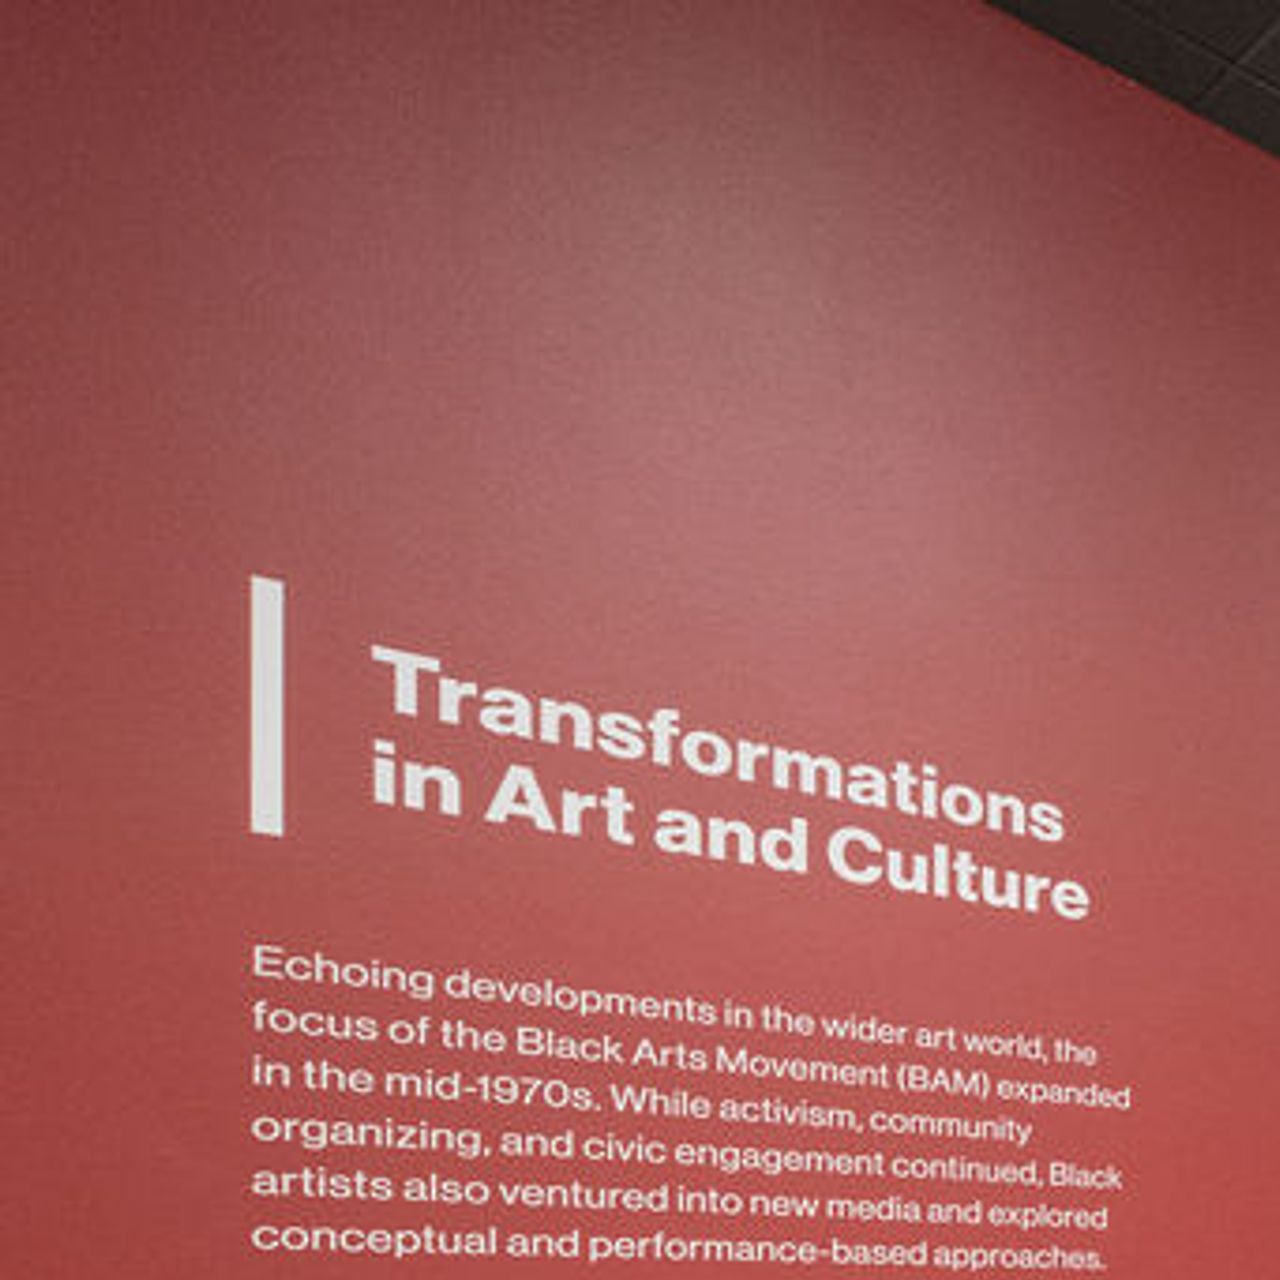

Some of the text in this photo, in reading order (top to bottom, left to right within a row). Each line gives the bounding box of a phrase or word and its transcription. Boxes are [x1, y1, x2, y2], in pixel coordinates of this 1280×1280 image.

[370, 644, 1065, 843] Transformations
[372, 738, 1091, 921] in Art and Culture
[252, 944, 1098, 1067] Echoing developments in the wider art world, the
[252, 999, 1132, 1111] focus of the Black Arts Movement (BAM) expanded
[252, 1053, 1033, 1148] in the mid-1970s. While activism, community
[250, 1115, 1123, 1190] organizing, and civic engagement continued, Black
[250, 1165, 1109, 1232] artists also ventured into new media and explored
[250, 1224, 1107, 1272] conceptual and performance-based approaches.
